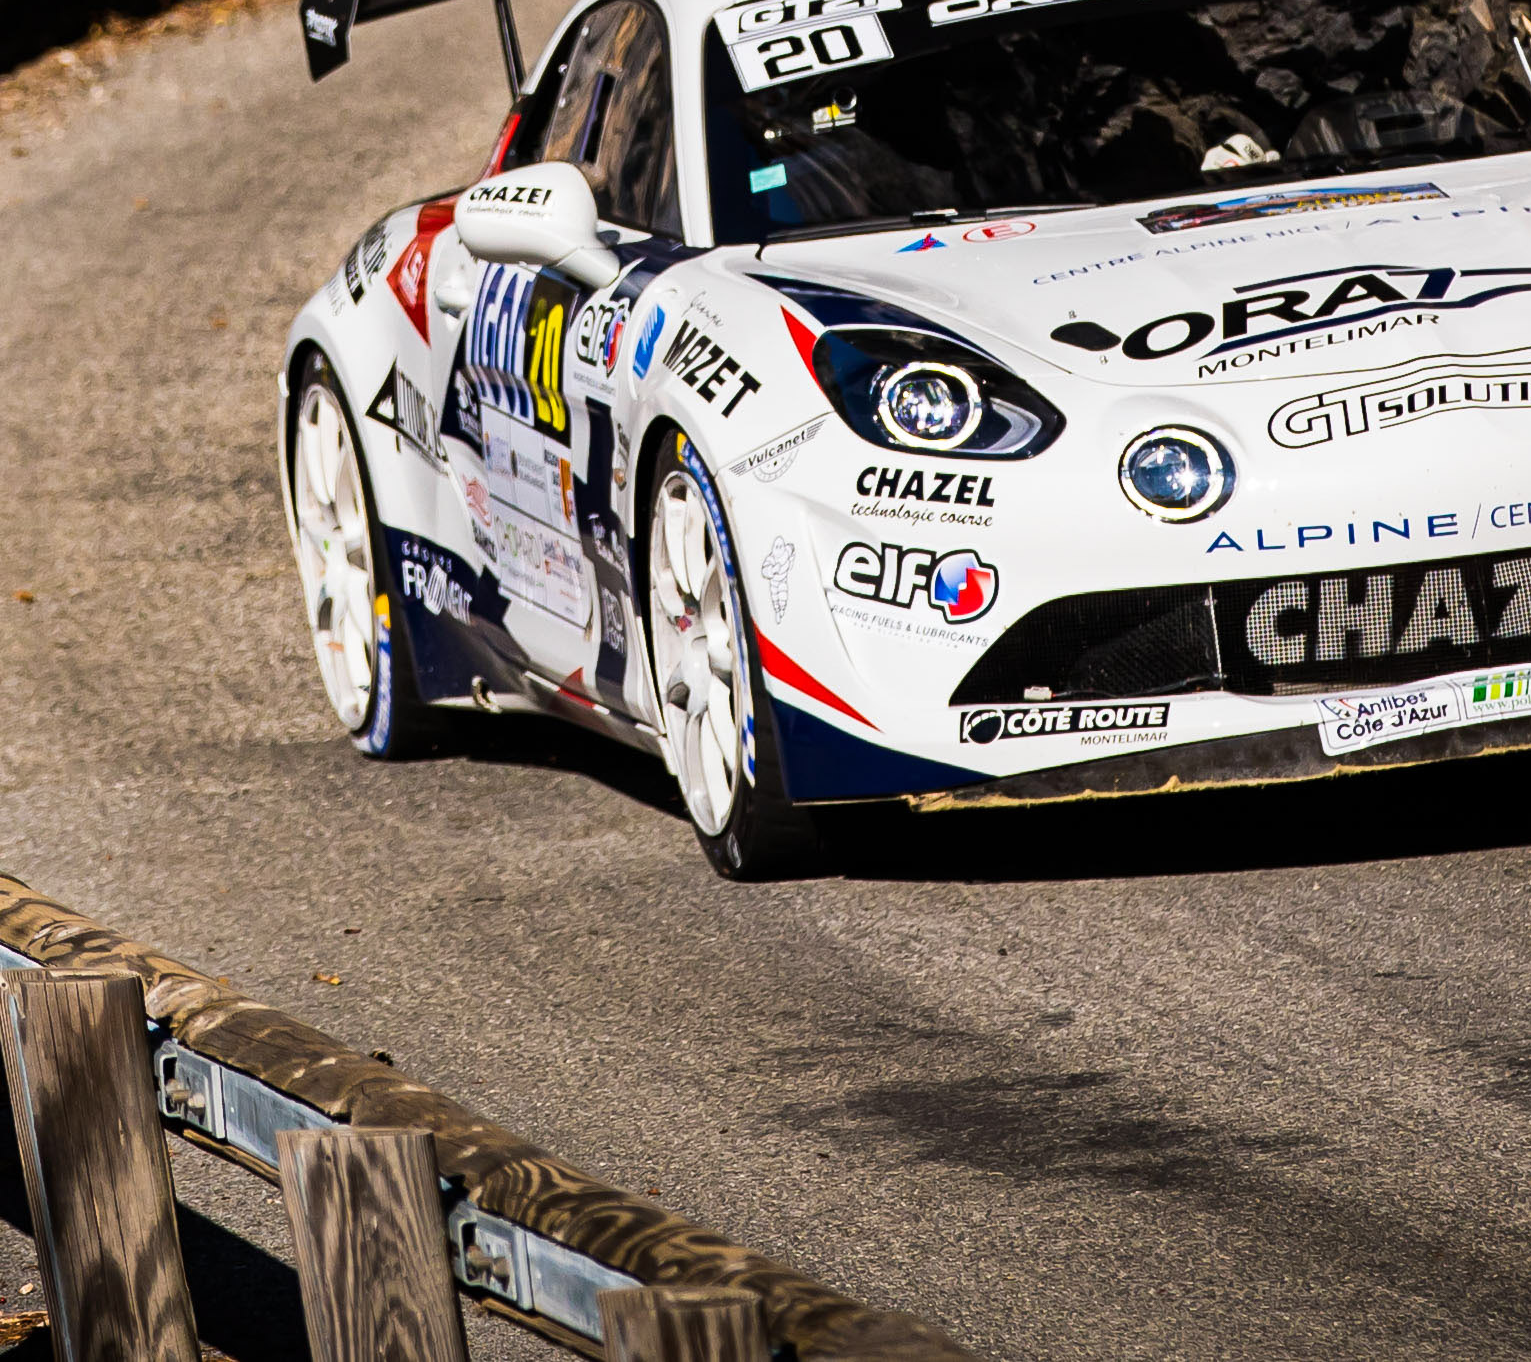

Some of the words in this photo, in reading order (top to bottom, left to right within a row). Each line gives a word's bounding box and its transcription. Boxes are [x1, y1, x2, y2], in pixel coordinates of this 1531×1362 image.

[757, 25, 864, 80] 20
[1033, 252, 1145, 286] CENTRE
[1155, 234, 1257, 257] ALPINE
[530, 298, 566, 432] 20
[1197, 312, 1441, 379] MONTELIMAR
[663, 319, 762, 418] MAZET
[748, 430, 807, 468] Vulcanet
[856, 466, 996, 508] CHAZEL
[1205, 512, 1459, 555] ALPINE
[834, 541, 938, 609] elf
[831, 604, 869, 622] RACING
[871, 615, 903, 631] FUELS
[916, 624, 990, 648] LUBRICANTS
[1007, 708, 1073, 734] CÔTÉ
[1078, 706, 1166, 729] ROUTE
[1357, 691, 1428, 718] Antibes
[1080, 731, 1168, 746] MONTELIMAR
[1336, 718, 1384, 740] Côte
